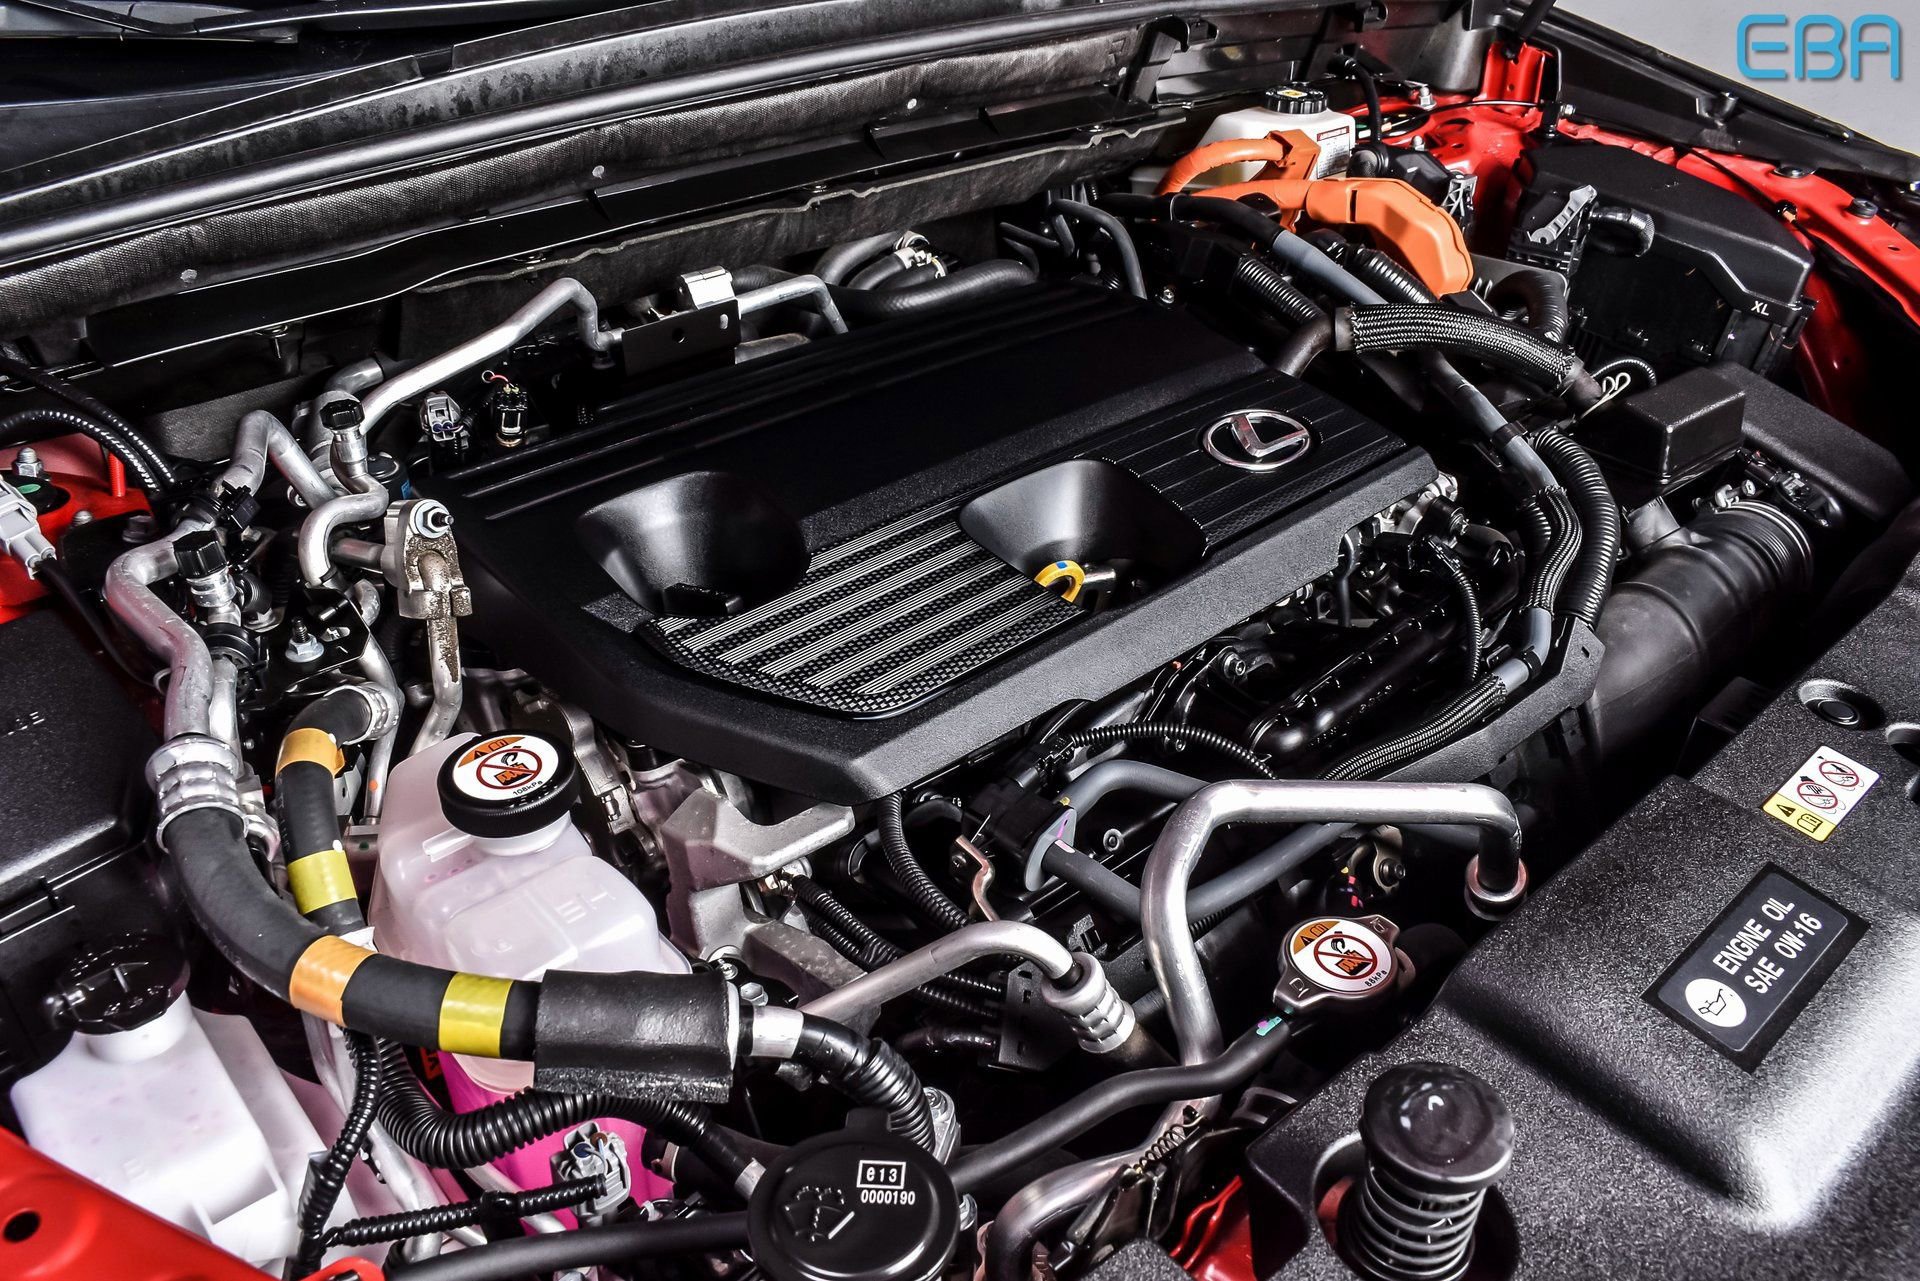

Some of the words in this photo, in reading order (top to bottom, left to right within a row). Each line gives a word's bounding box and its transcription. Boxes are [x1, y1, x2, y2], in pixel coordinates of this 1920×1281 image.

[1750, 300, 1770, 316] XL
[512, 780, 544, 796] 108kPa
[1712, 918, 1772, 975] ENGINE
[1761, 897, 1796, 921] OIL
[1744, 956, 1785, 994] SAE
[1773, 912, 1823, 959] 0W-16
[1364, 970, 1388, 987] 88kPa
[866, 1166, 898, 1183] e13
[860, 1189, 916, 1206] 0000190
